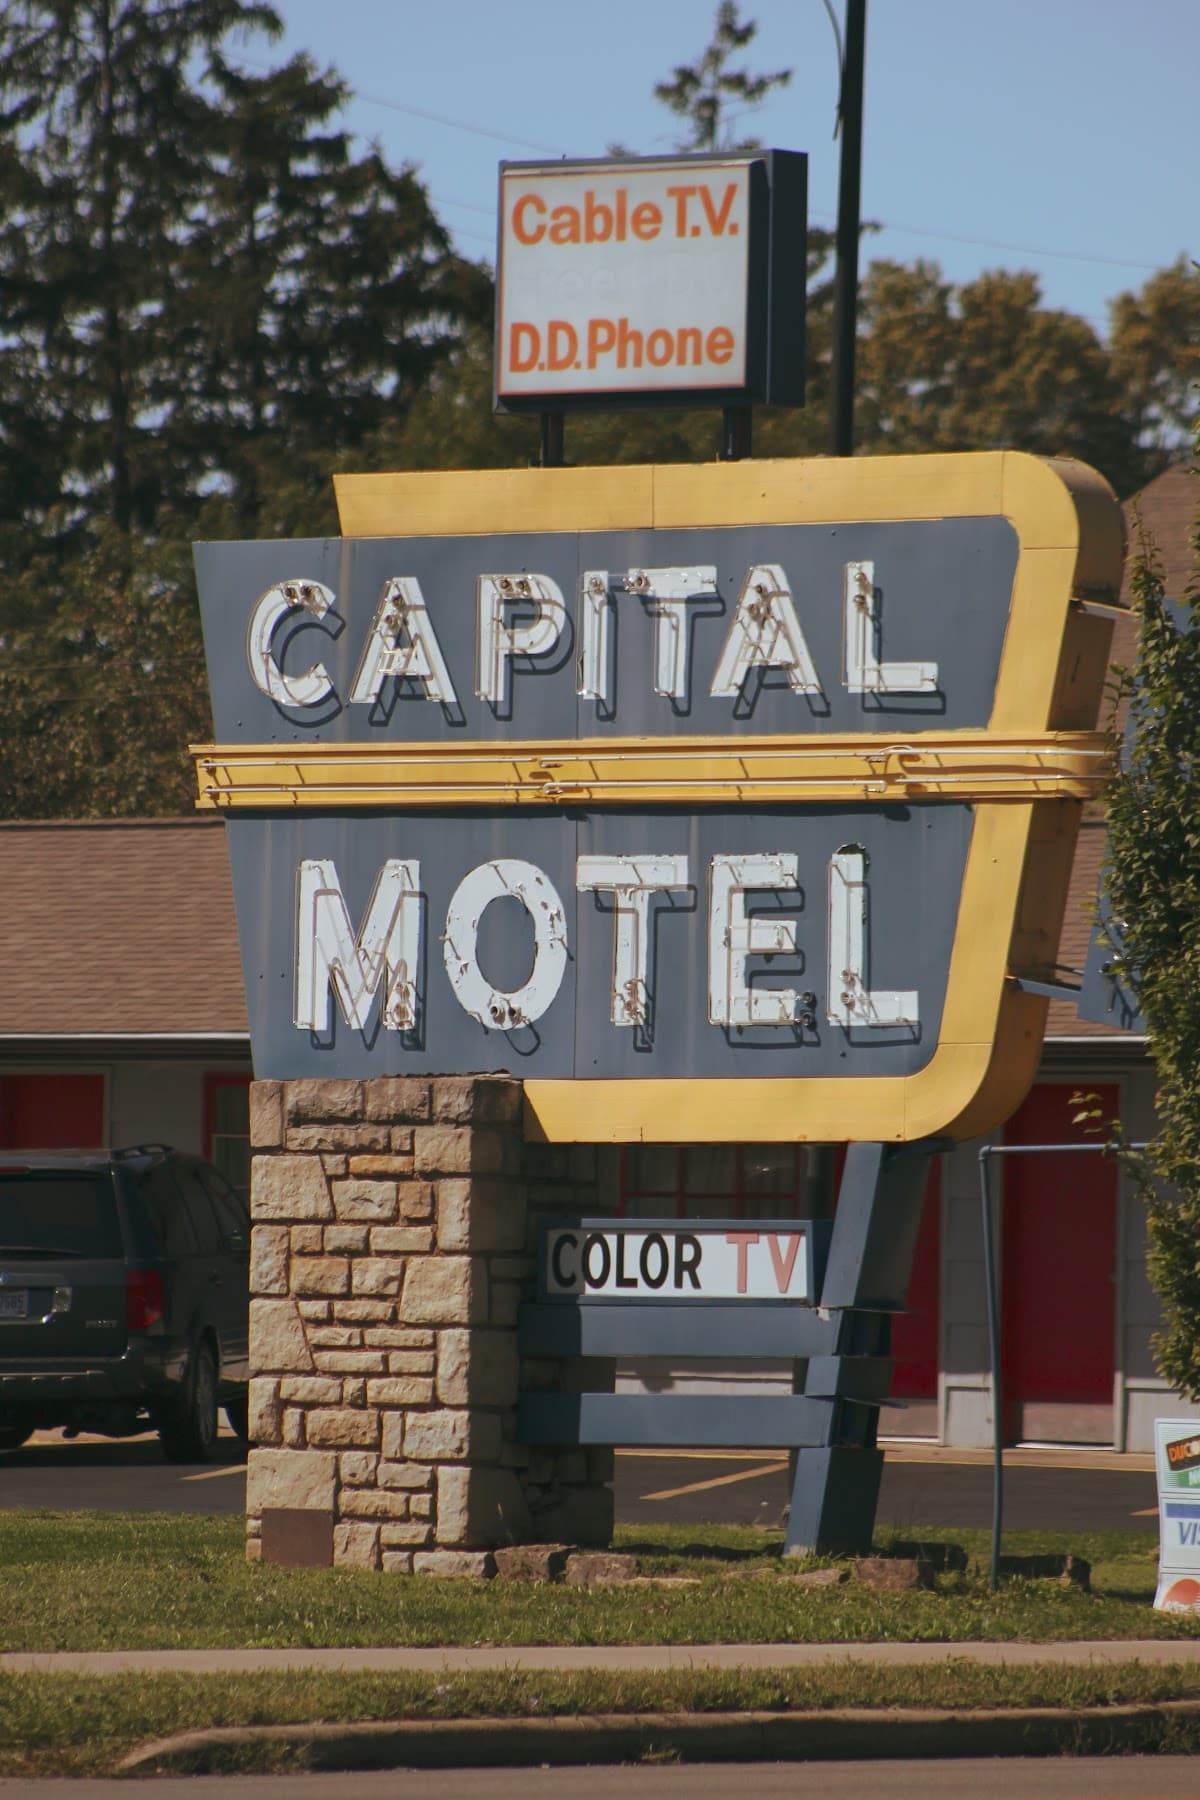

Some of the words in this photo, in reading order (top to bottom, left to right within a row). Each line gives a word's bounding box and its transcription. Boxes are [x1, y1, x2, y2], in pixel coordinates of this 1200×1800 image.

[511, 188, 663, 246] Cable
[667, 183, 739, 238] T.V.
[508, 320, 582, 373] D.D.
[586, 318, 735, 370] Phone
[247, 561, 939, 707] CAPITAL
[293, 853, 920, 1031] MOTEL
[551, 1232, 702, 1289] COLOR
[726, 1231, 800, 1293] TV
